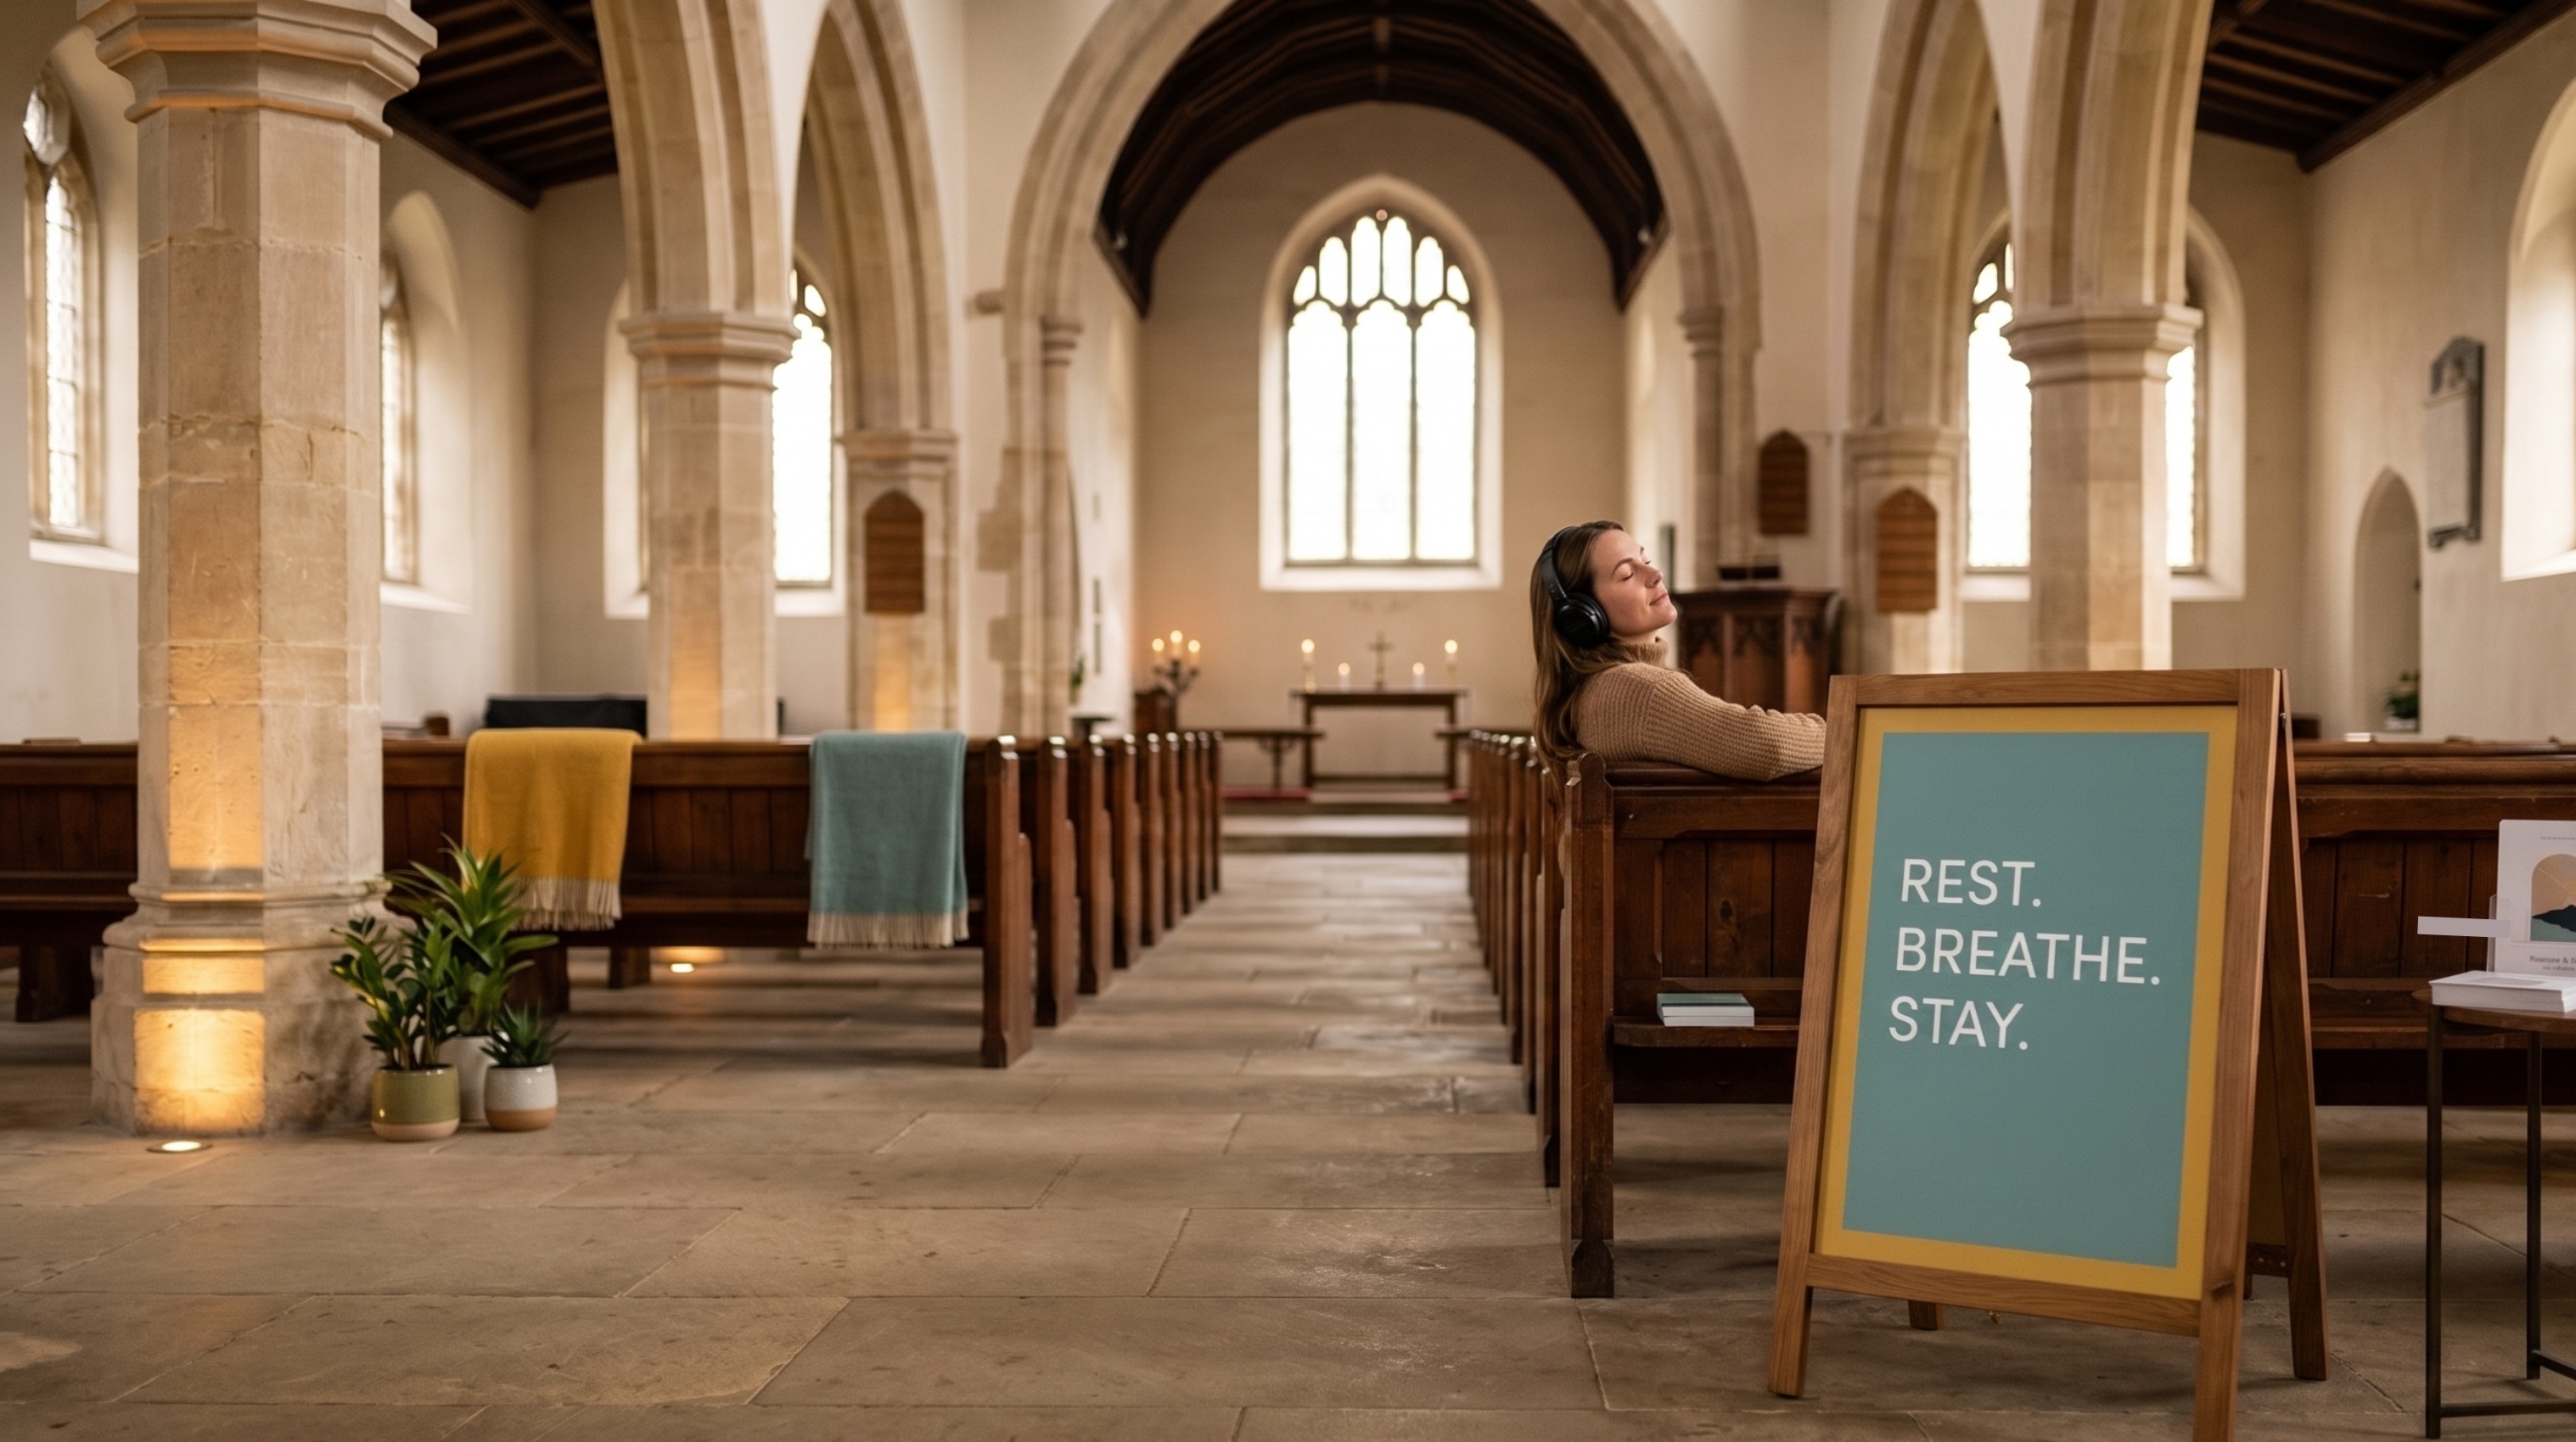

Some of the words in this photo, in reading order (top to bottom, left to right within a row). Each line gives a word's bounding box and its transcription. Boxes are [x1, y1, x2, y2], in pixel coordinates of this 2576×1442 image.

[1900, 858, 2041, 907] REST.
[1895, 926, 2160, 985] BREATHE.
[1889, 995, 2029, 1051] STAY.
